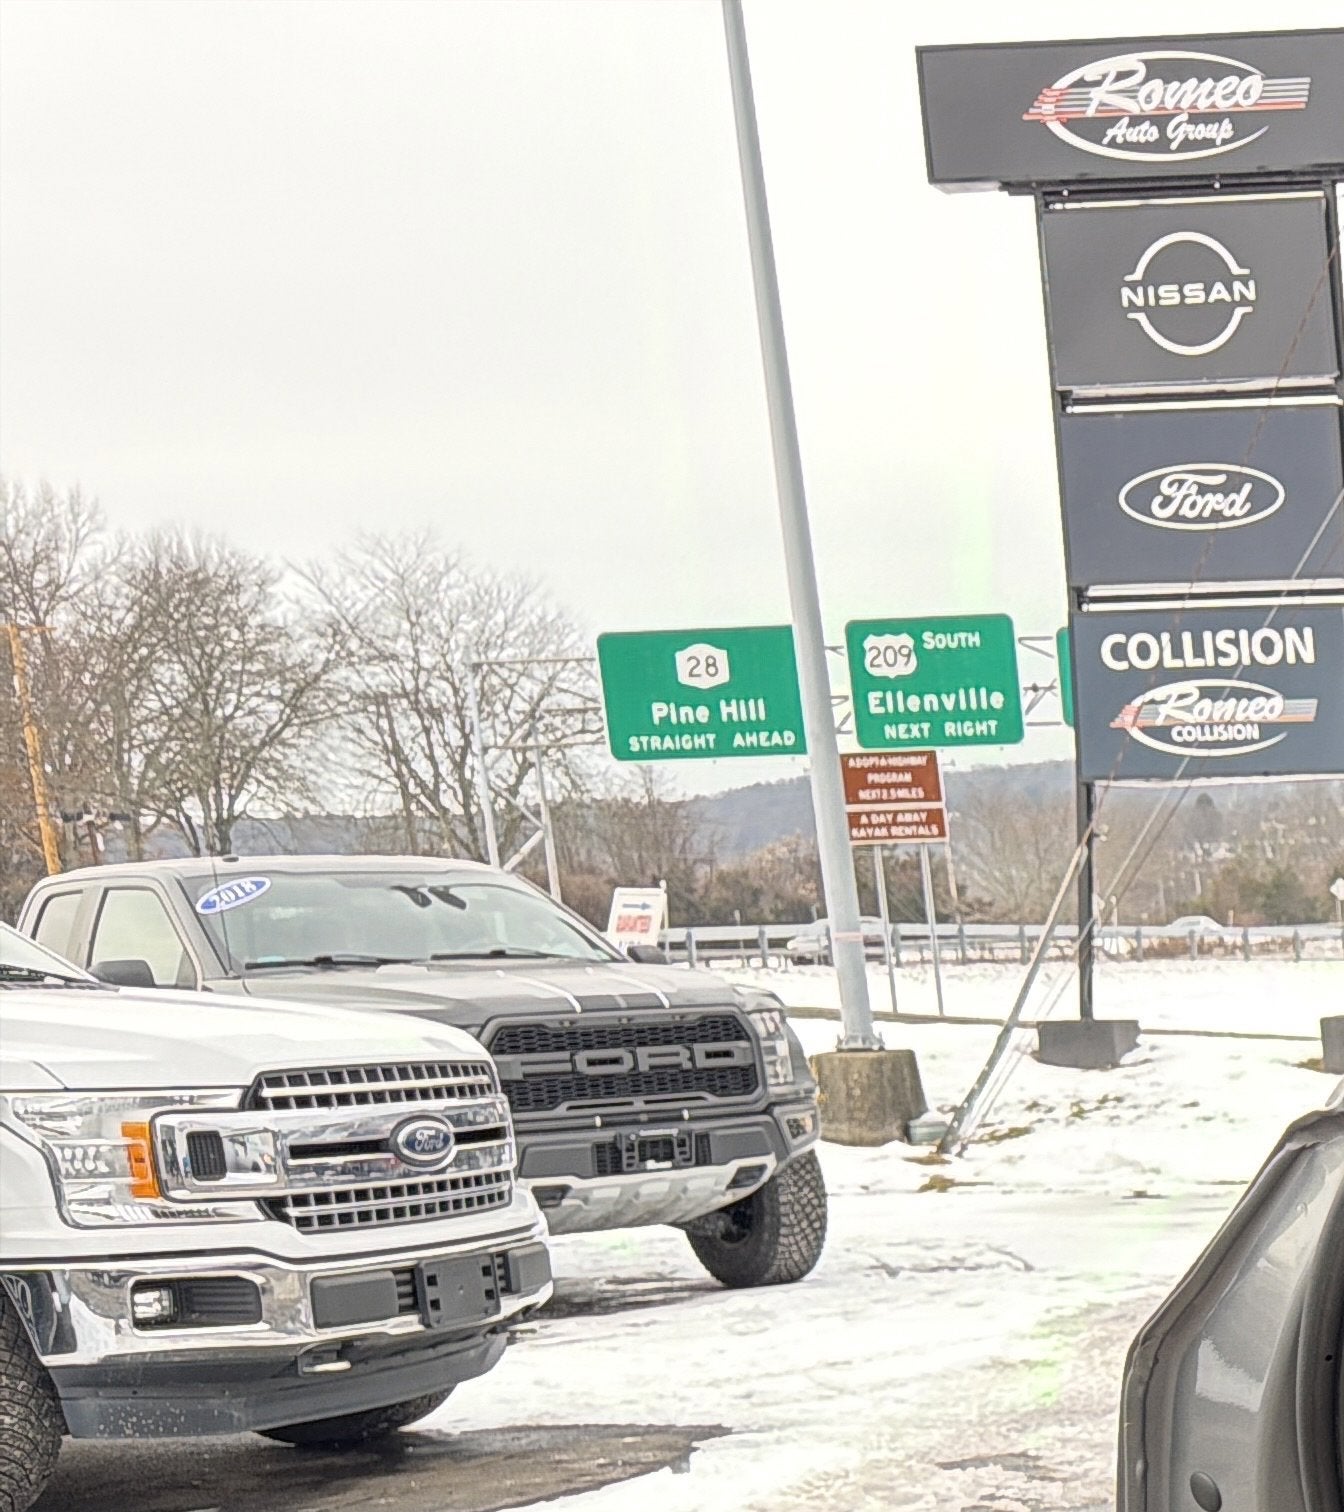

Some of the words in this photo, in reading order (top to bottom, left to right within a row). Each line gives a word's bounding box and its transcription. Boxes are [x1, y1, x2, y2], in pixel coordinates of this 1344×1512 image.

[1083, 59, 1264, 117] Romeo
[1102, 116, 1160, 145] Auto
[1166, 112, 1234, 150] Group
[1120, 280, 1257, 309] NISSAN
[1150, 473, 1253, 519] Ford
[868, 645, 913, 668] 209
[921, 630, 981, 650] SOUTH
[1100, 627, 1315, 671] COLLISION
[686, 655, 719, 678] 28
[651, 701, 710, 726] Pine
[719, 698, 767, 723] Hill
[867, 687, 1005, 715] Ellenville
[1146, 686, 1285, 727] Romeo
[628, 733, 717, 752] STRAIGHT
[732, 730, 797, 749] AHEAD
[884, 722, 932, 740] NEXT
[944, 719, 999, 738] RIGHT
[1170, 723, 1261, 743] COLLISION
[207, 880, 258, 909] 2018
[495, 1043, 758, 1082] FORD
[414, 1129, 445, 1152] Ford
